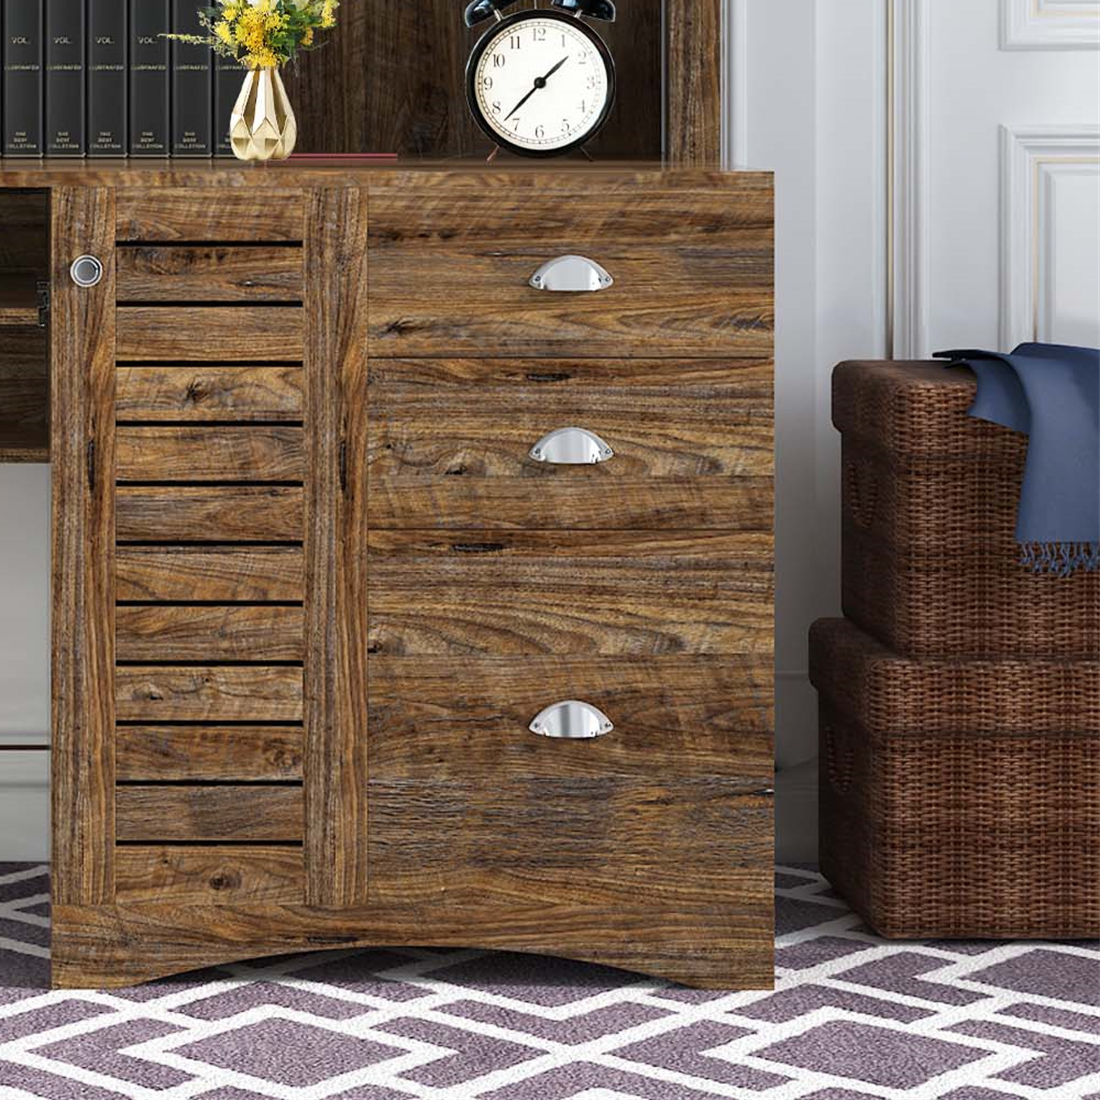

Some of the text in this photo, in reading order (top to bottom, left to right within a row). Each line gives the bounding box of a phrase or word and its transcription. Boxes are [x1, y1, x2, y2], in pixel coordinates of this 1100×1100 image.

[533, 28, 546, 41] 12
[560, 34, 566, 48] 1
[510, 36, 520, 49] 11
[493, 54, 505, 68] 10
[578, 52, 587, 64] 2
[484, 77, 492, 90] 9
[587, 76, 595, 89] 3
[492, 101, 501, 114] 8
[577, 100, 585, 113] 4
[512, 118, 520, 131] 7
[561, 119, 569, 132] 5
[535, 125, 544, 138] 6
